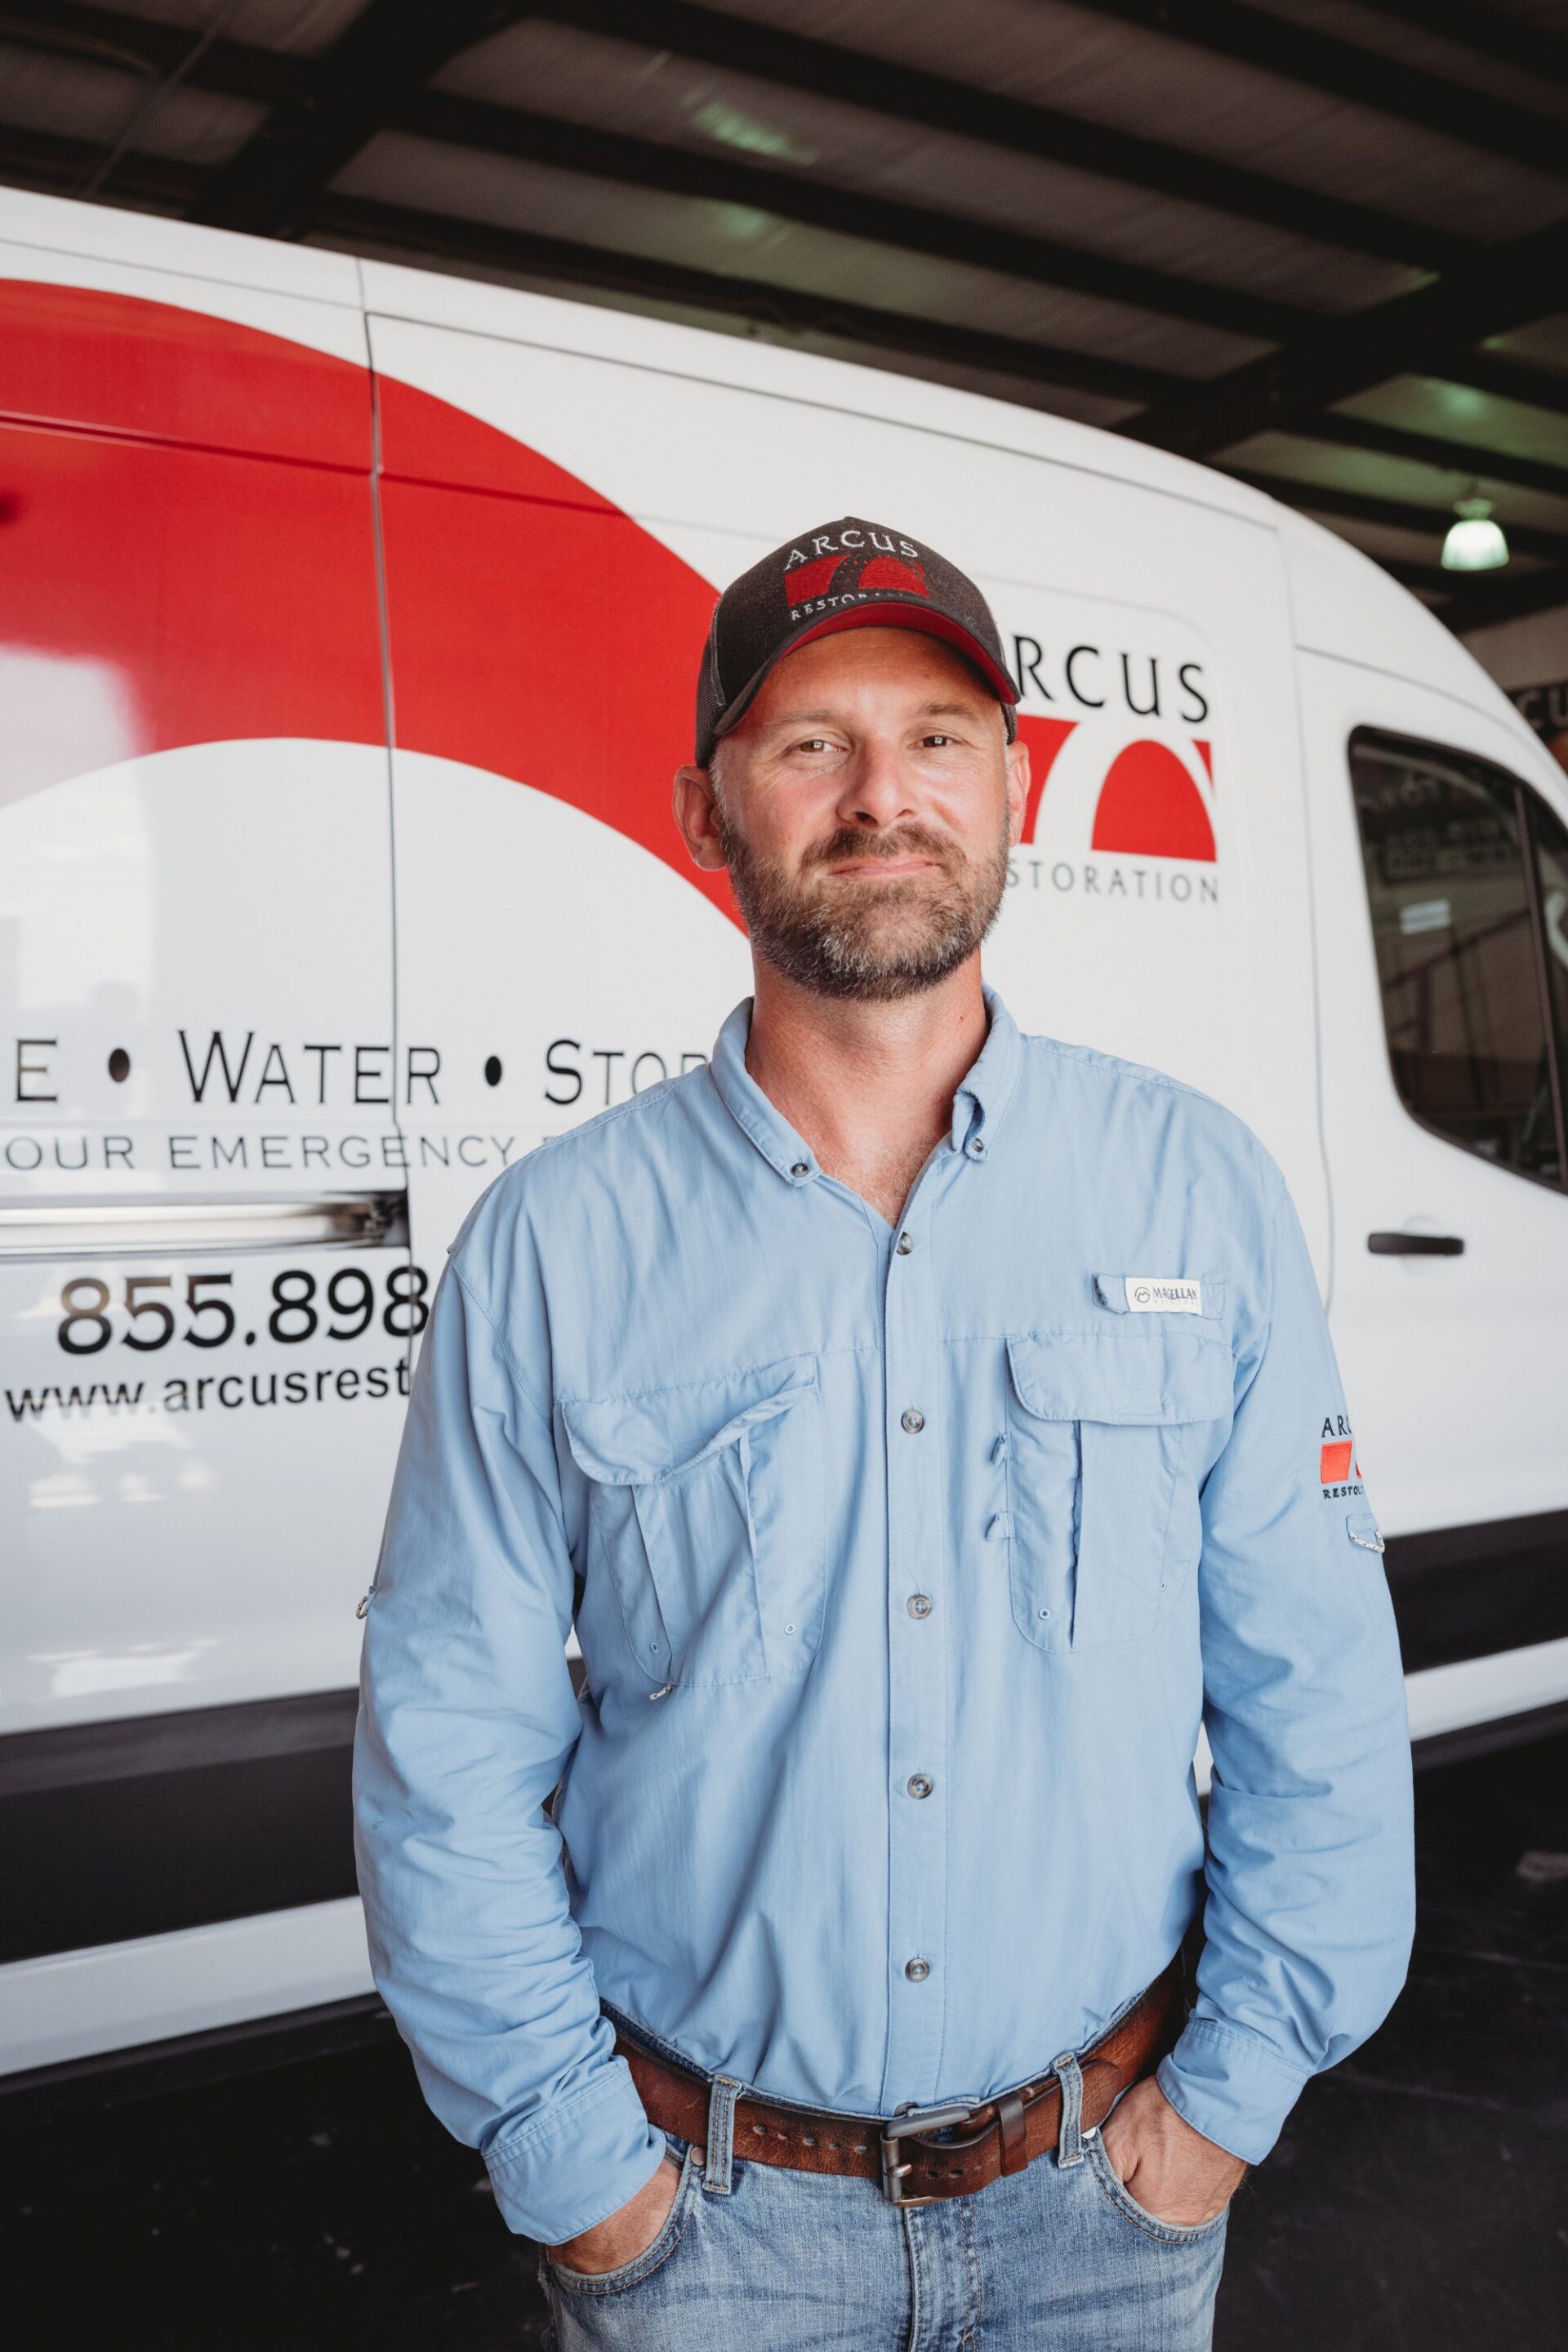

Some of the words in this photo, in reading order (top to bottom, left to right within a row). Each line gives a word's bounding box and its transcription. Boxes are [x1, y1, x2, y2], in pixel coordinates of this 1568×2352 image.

[784, 529, 920, 572] ARCUS
[791, 593, 867, 621] RESTO
[1013, 635, 1209, 724] RCUS
[16, 1039, 58, 1102] E
[178, 1030, 440, 1105] WATER
[5, 1136, 134, 1170] OUR
[168, 1135, 514, 1169] EMERGENCY
[57, 1266, 430, 1356] 855.898
[1152, 1287, 1197, 1300] MAGELLAN
[5, 1358, 410, 1422] www.arcusrest
